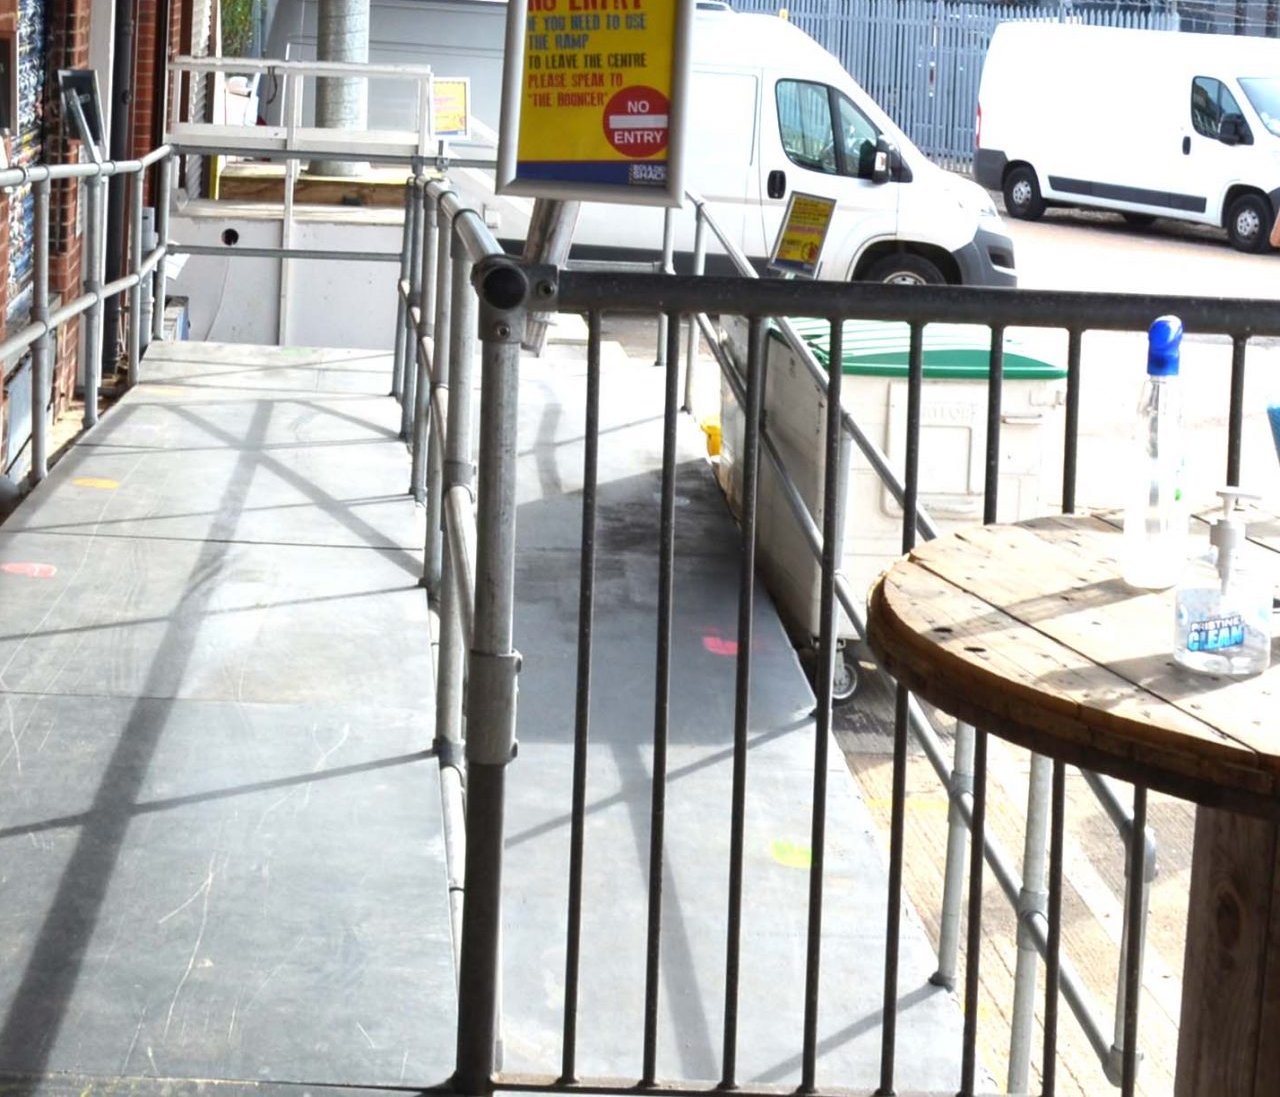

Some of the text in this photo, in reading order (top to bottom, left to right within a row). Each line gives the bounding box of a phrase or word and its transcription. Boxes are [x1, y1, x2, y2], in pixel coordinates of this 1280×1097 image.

[543, 15, 566, 31] YOU
[570, 14, 600, 31] NEED
[605, 14, 621, 31] TO
[625, 13, 647, 31] USE
[528, 34, 590, 51] THE RAMP
[528, 52, 648, 69] TO LEAVE THE CENTRE
[528, 72, 624, 89] PLEASE SPEAK TO
[627, 100, 650, 113] NO
[613, 130, 664, 145] ENTRY
[1191, 615, 1243, 632] PRISTINE
[1187, 625, 1245, 652] CLEAN
